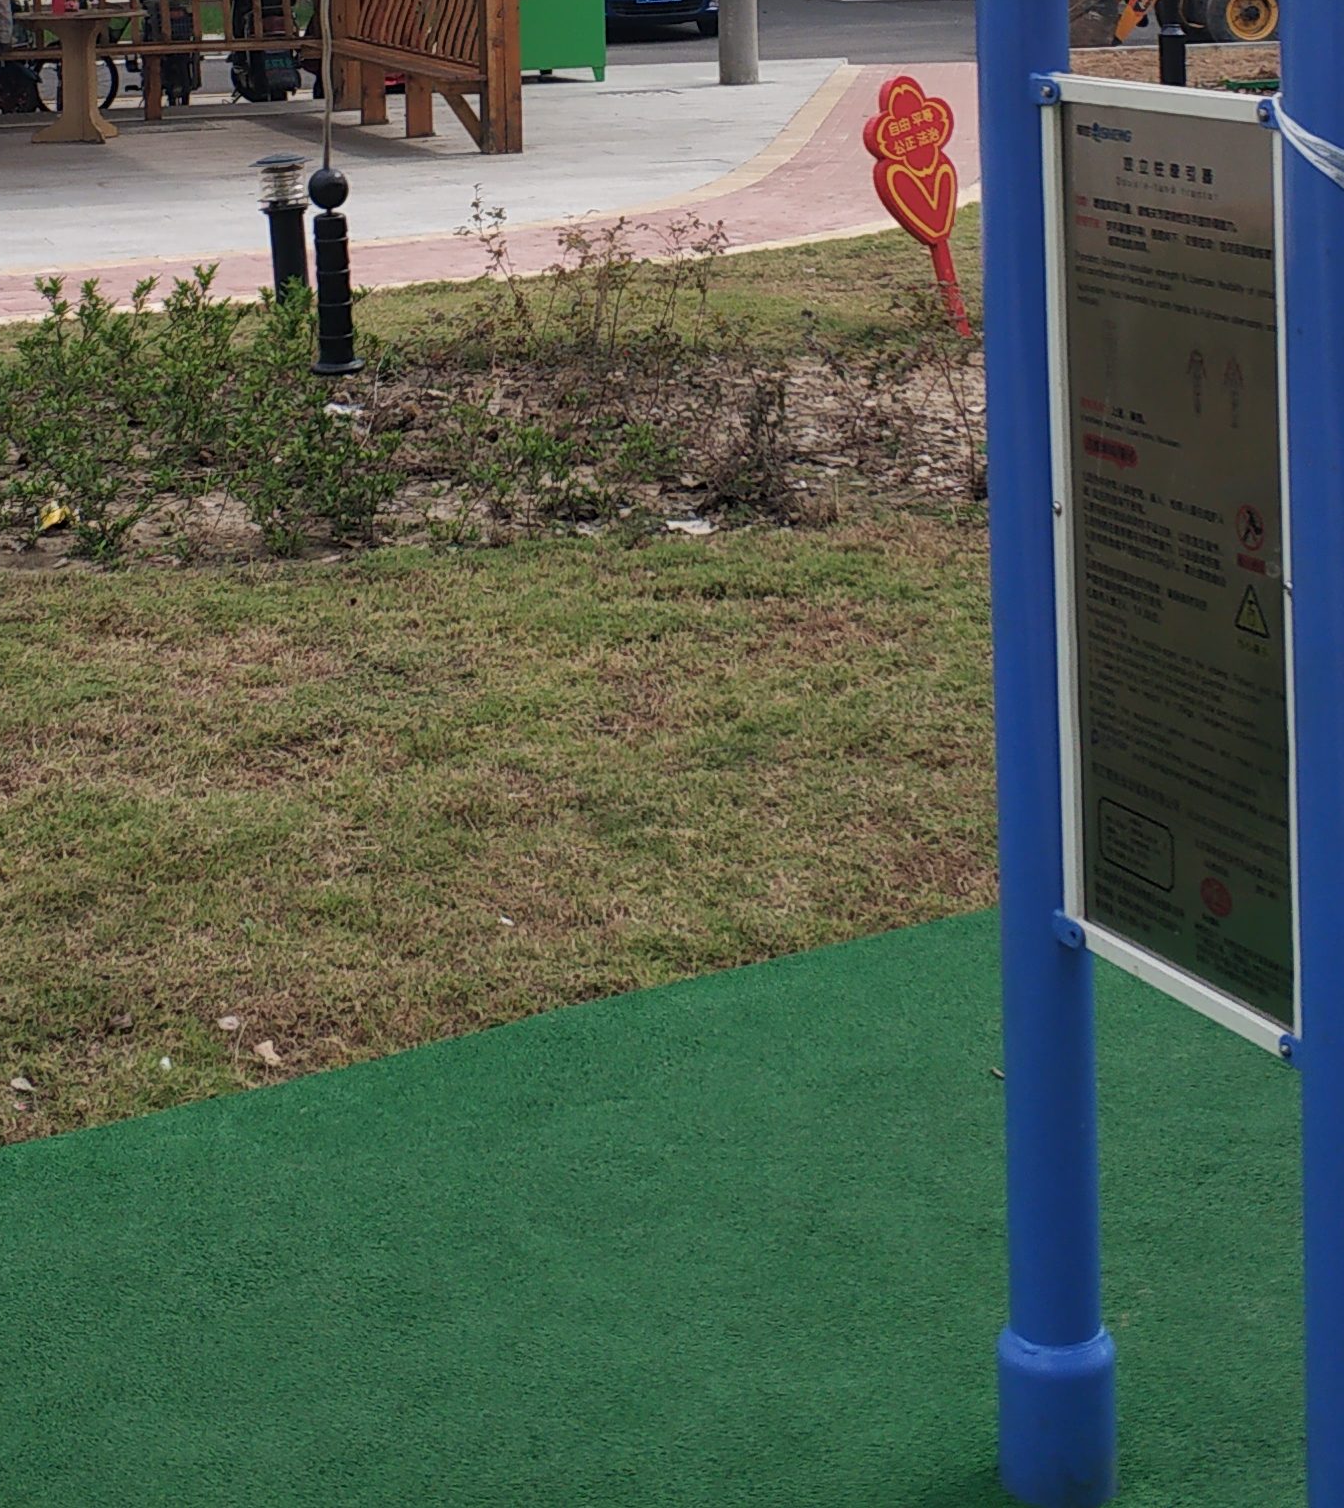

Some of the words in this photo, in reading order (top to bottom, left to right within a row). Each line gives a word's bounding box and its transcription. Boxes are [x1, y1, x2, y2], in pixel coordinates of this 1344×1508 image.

[888, 118, 911, 136] 自由
[894, 136, 917, 154] 公正
[916, 127, 939, 146] 法治
